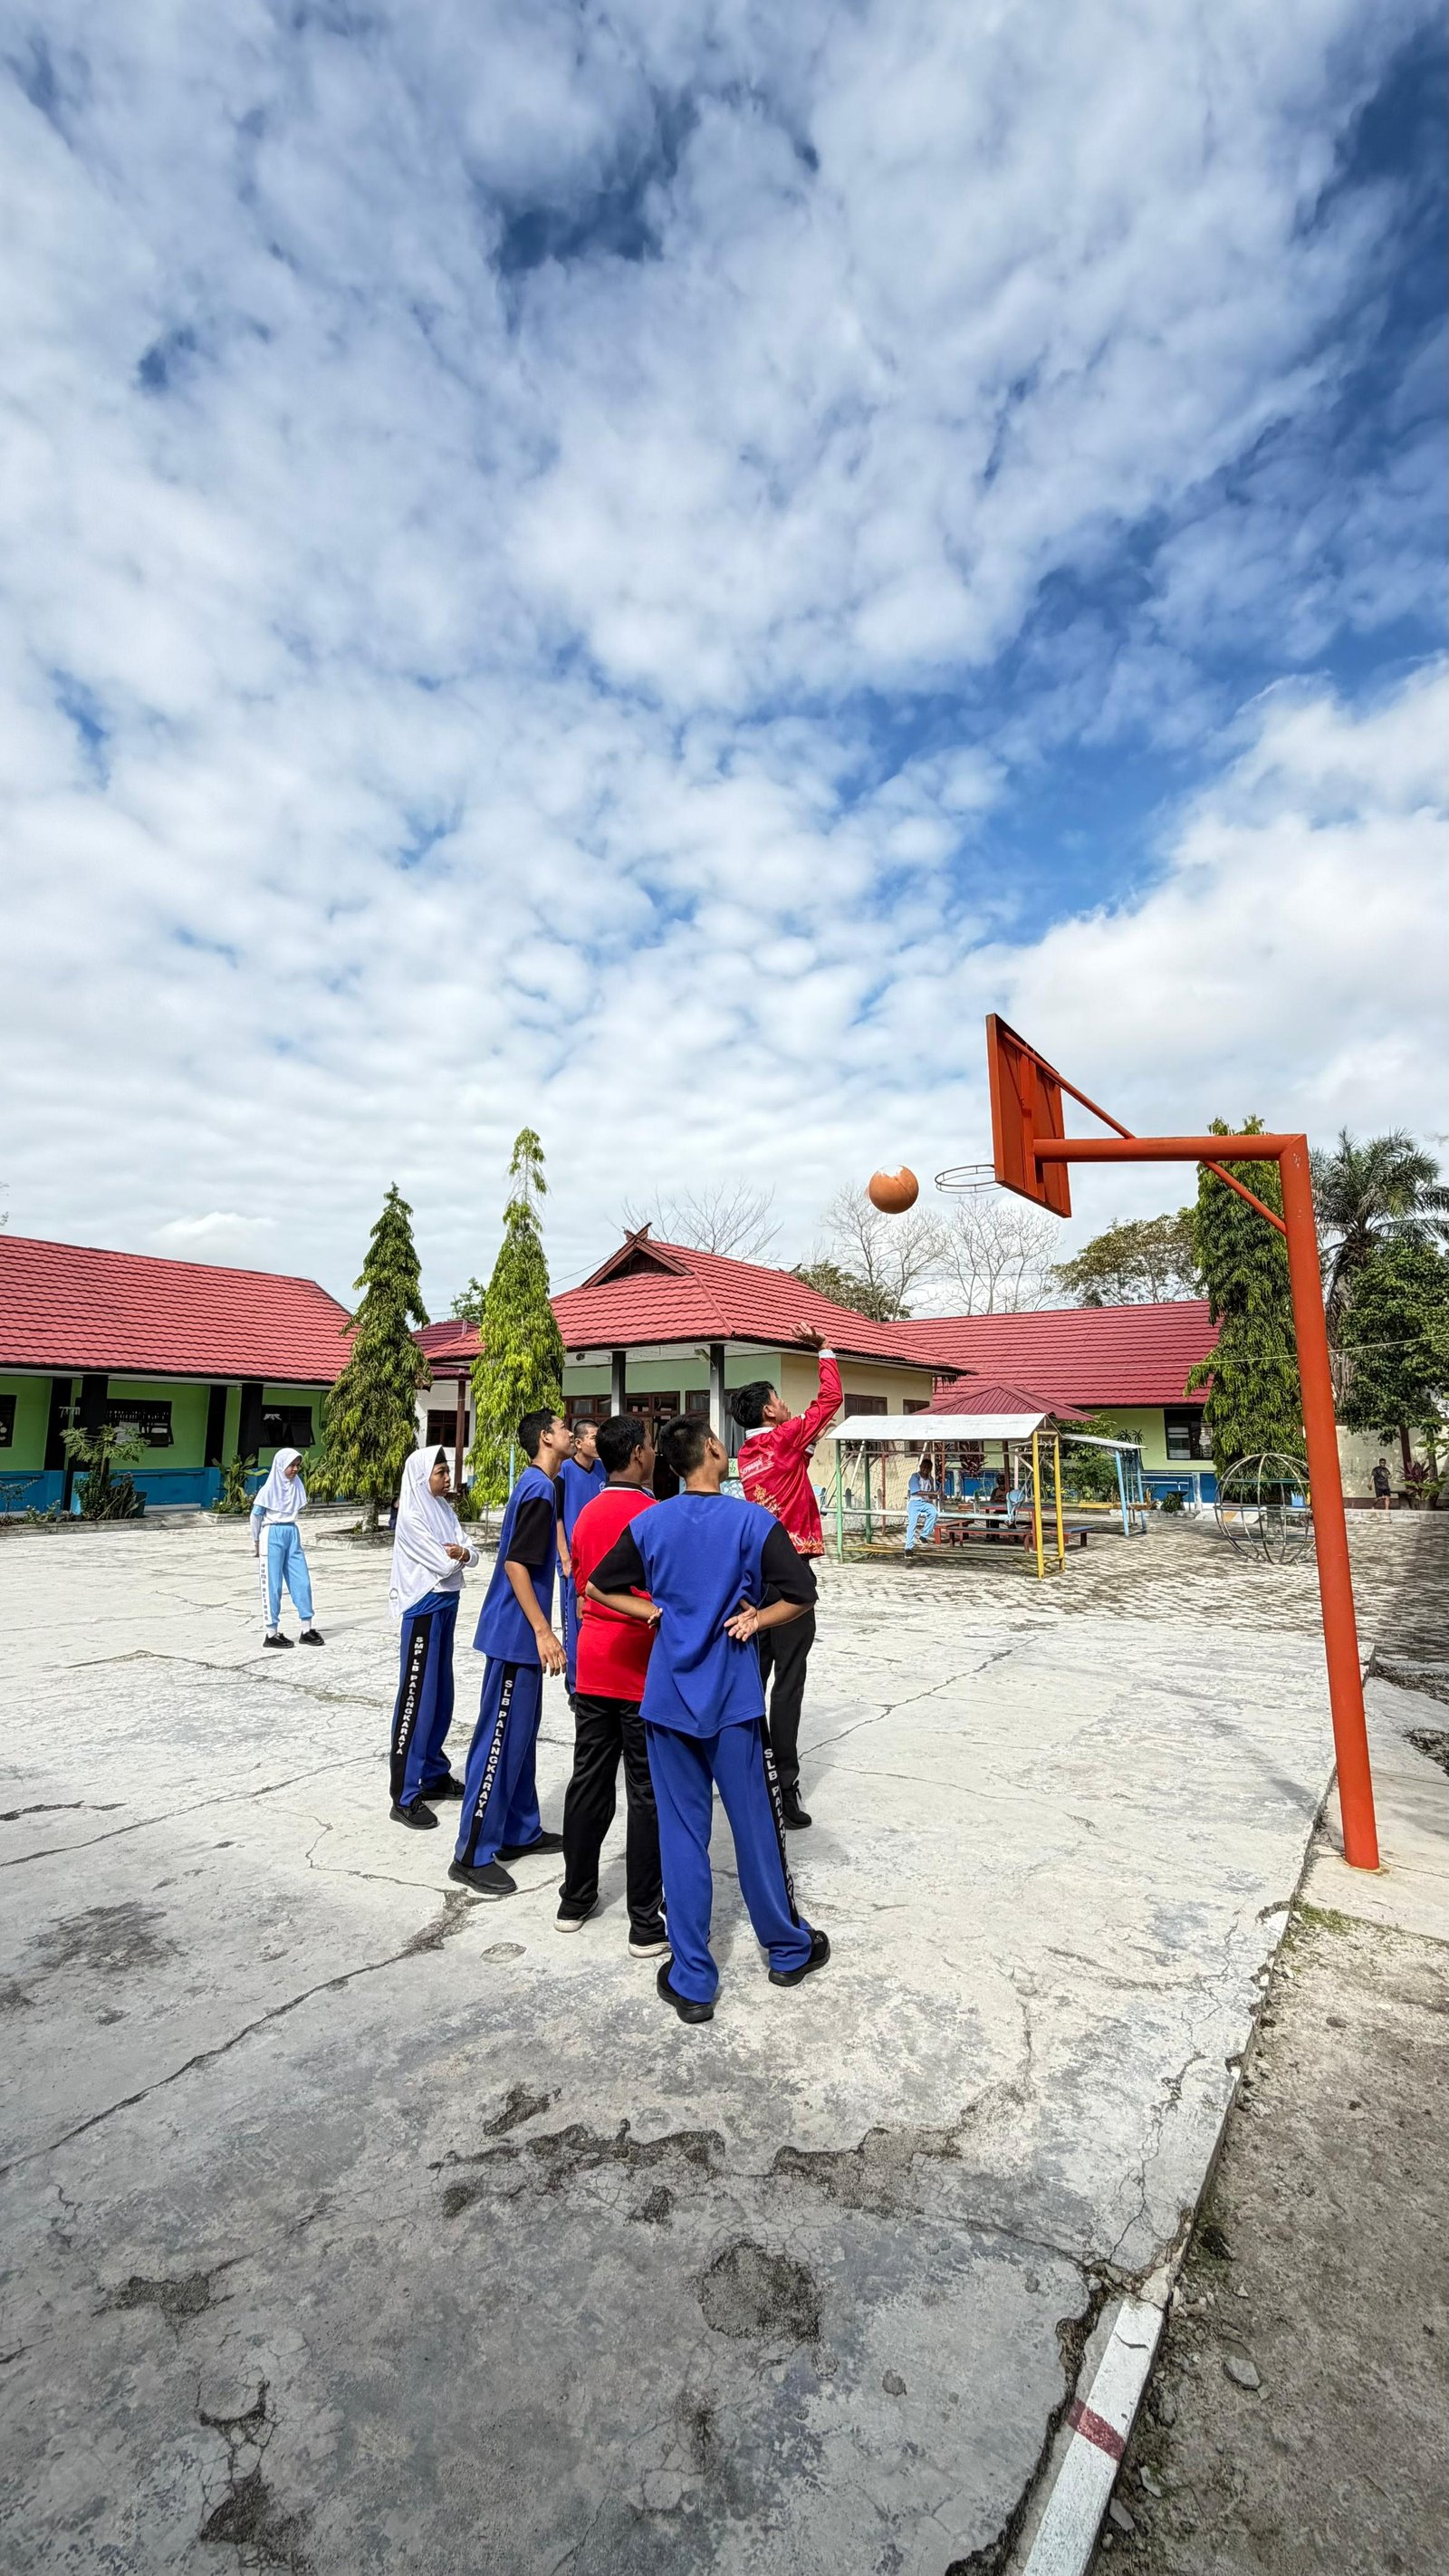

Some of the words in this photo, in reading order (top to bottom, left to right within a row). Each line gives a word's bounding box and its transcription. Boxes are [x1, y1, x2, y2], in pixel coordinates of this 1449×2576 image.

[414, 1637, 424, 1656] SMP
[411, 1658, 419, 1672] LB
[501, 1679, 513, 1706] SLB
[396, 1675, 418, 1754] PALANGKARAYA
[475, 1710, 507, 1818] PALANGKARAYA
[763, 1748, 778, 1781] SLB
